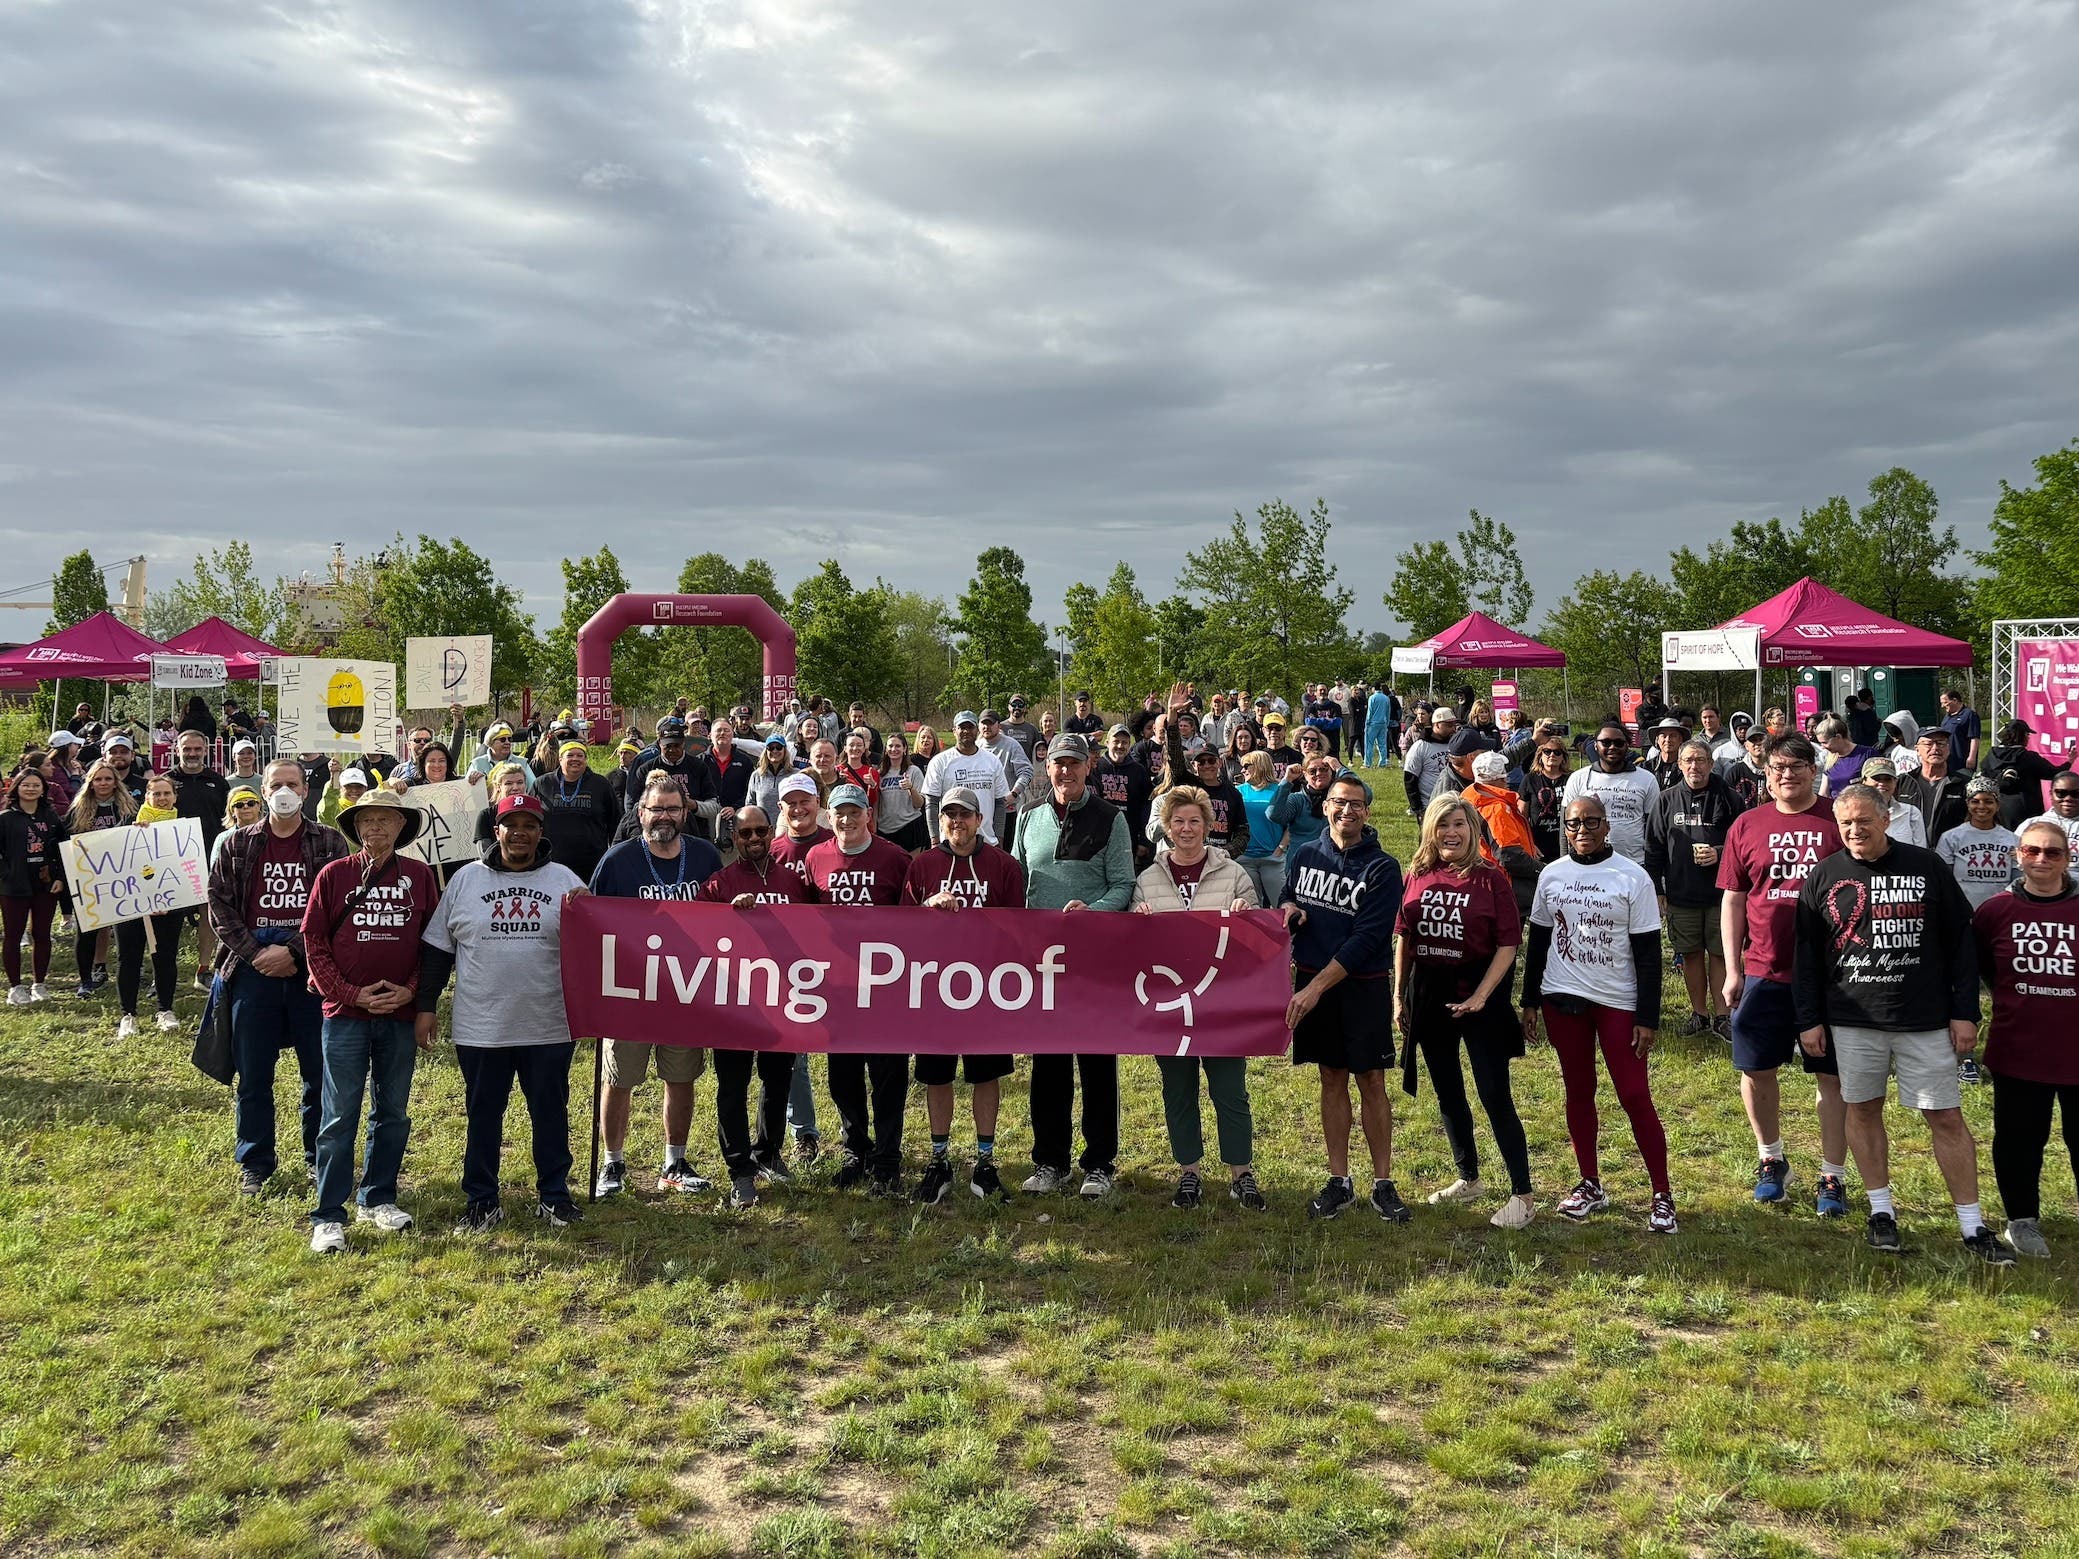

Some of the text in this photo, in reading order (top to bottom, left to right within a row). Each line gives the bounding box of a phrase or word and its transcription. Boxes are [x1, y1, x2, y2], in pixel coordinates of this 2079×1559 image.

[1680, 643, 1724, 654] SPIRIT OF HOPE
[180, 664, 193, 678] Kid
[195, 665, 213, 679] Zone
[416, 656, 432, 694] DAVE
[444, 649, 467, 690] D
[279, 663, 301, 751] DAVE THE
[373, 669, 392, 754] MINION!
[1101, 774, 1129, 785] PATH
[1103, 782, 1117, 791] TO
[1118, 784, 1127, 793] A
[1768, 831, 1823, 848] PATH
[77, 825, 201, 875] WALK
[416, 835, 452, 864] VE
[1770, 847, 1818, 863] TO A
[1958, 843, 2010, 857] WARRIO
[262, 862, 306, 877] PATH
[1967, 869, 2007, 880] SQUAD
[94, 875, 141, 905] FOR
[157, 867, 182, 889] A
[264, 877, 306, 893] TO A
[827, 871, 875, 888] PATH
[1870, 875, 1926, 890] IN THIS
[115, 889, 182, 917] CURE
[259, 893, 308, 909] CURE
[480, 886, 553, 906] WARRIOR
[752, 892, 790, 904] ATH
[829, 887, 872, 903] TO A
[971, 896, 984, 908] A
[1420, 889, 1471, 908] PATH
[1553, 893, 1613, 909] Myeloma Warrior
[1870, 890, 1926, 905] FAMILY
[365, 902, 394, 911] TO A
[1421, 904, 1463, 924] TO A
[1871, 904, 1926, 919] NO ONE
[352, 912, 405, 927] CURE
[1578, 912, 1614, 931] Fighting
[1871, 918, 1924, 934] FIGHTS
[490, 922, 541, 935] SQUAD
[1416, 921, 1465, 941] CURE
[2011, 921, 2076, 941] PATH
[1578, 931, 1613, 949] Every Step
[1872, 933, 1921, 950] ALONE
[2013, 939, 2073, 957] TO A
[1587, 950, 1597, 964] the
[1598, 952, 1615, 967] Way
[1834, 953, 1920, 971] Multiple Myeloma
[2011, 956, 2076, 977] CURE
[601, 933, 1066, 1024] Living Proof
[1848, 970, 1905, 983] Awareness
